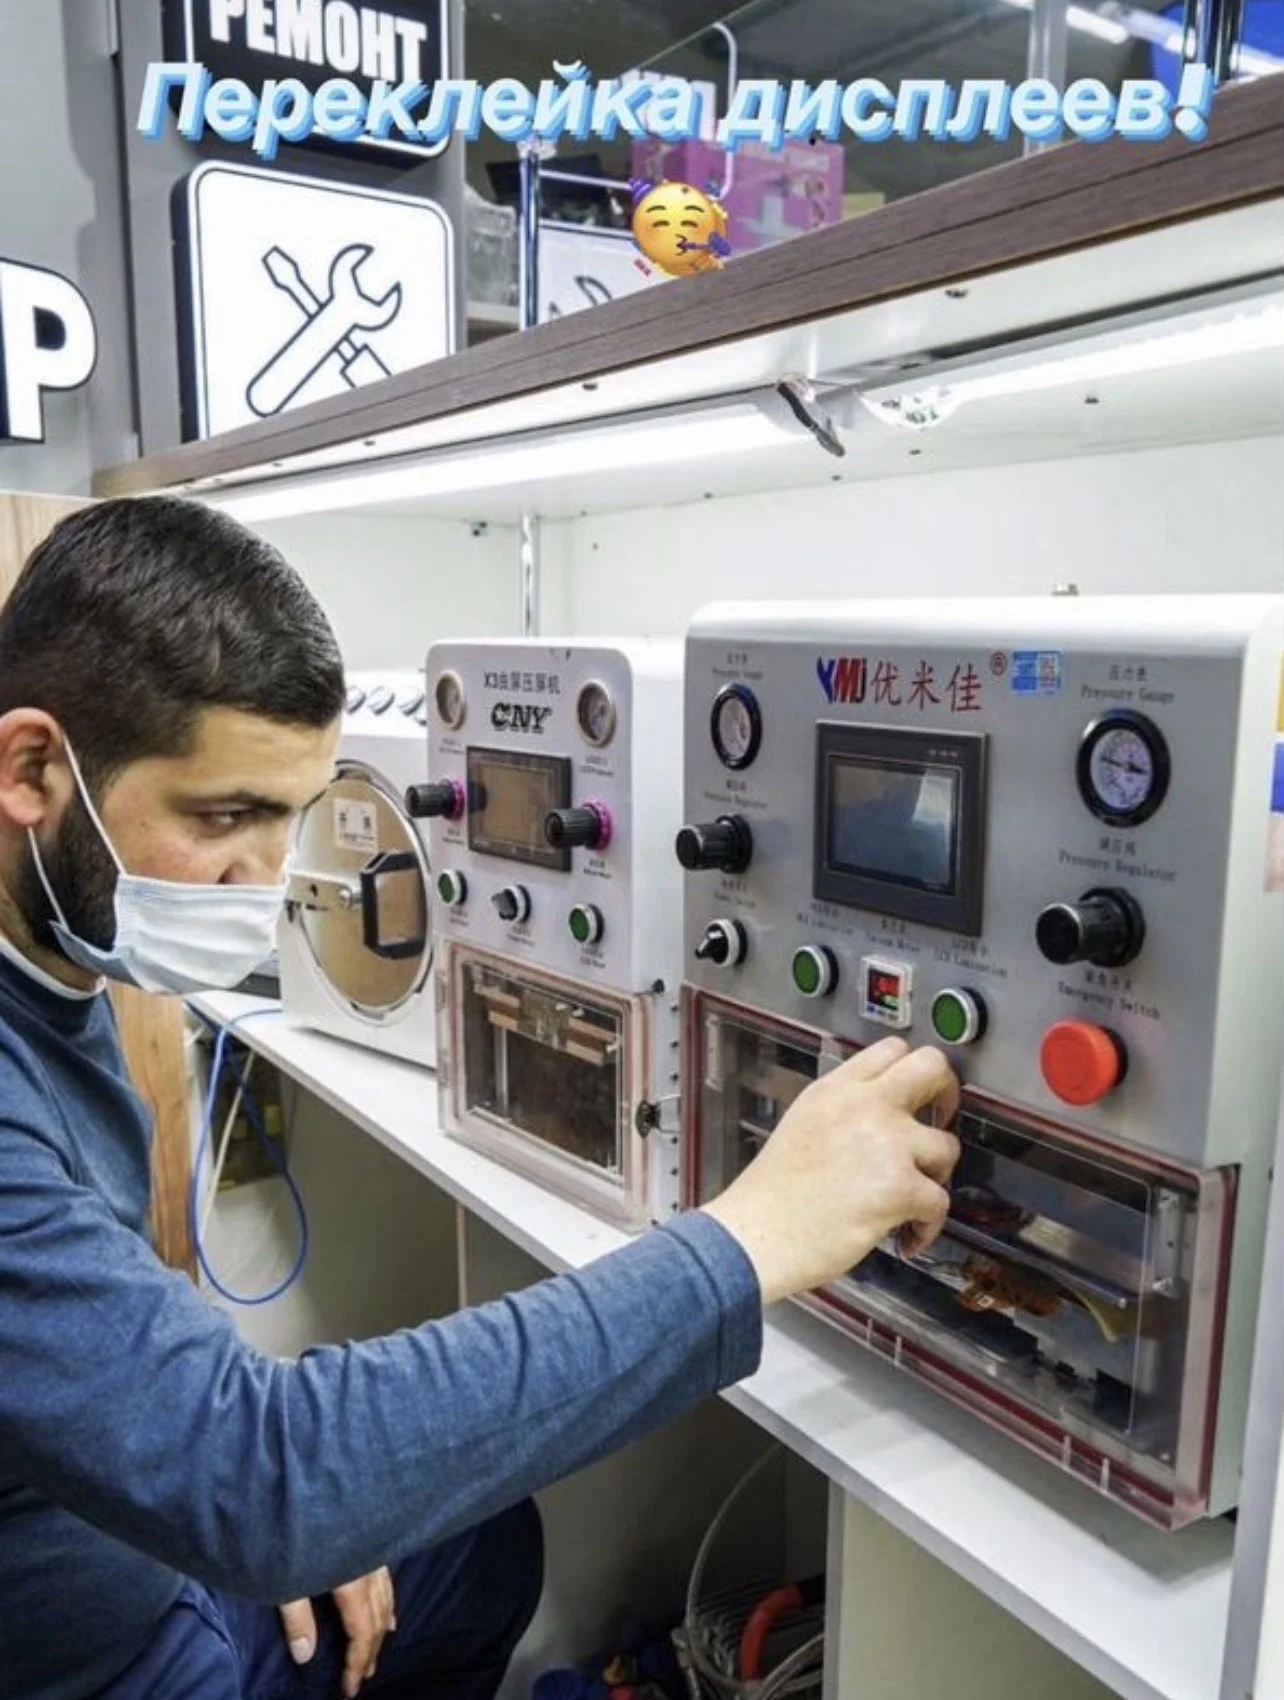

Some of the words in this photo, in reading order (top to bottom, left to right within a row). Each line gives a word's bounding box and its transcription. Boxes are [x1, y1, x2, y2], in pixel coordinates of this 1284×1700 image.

[209, 0, 428, 82] РЕМОНТ
[870, 660, 983, 713] 优米佳
[490, 701, 553, 734] CNY
